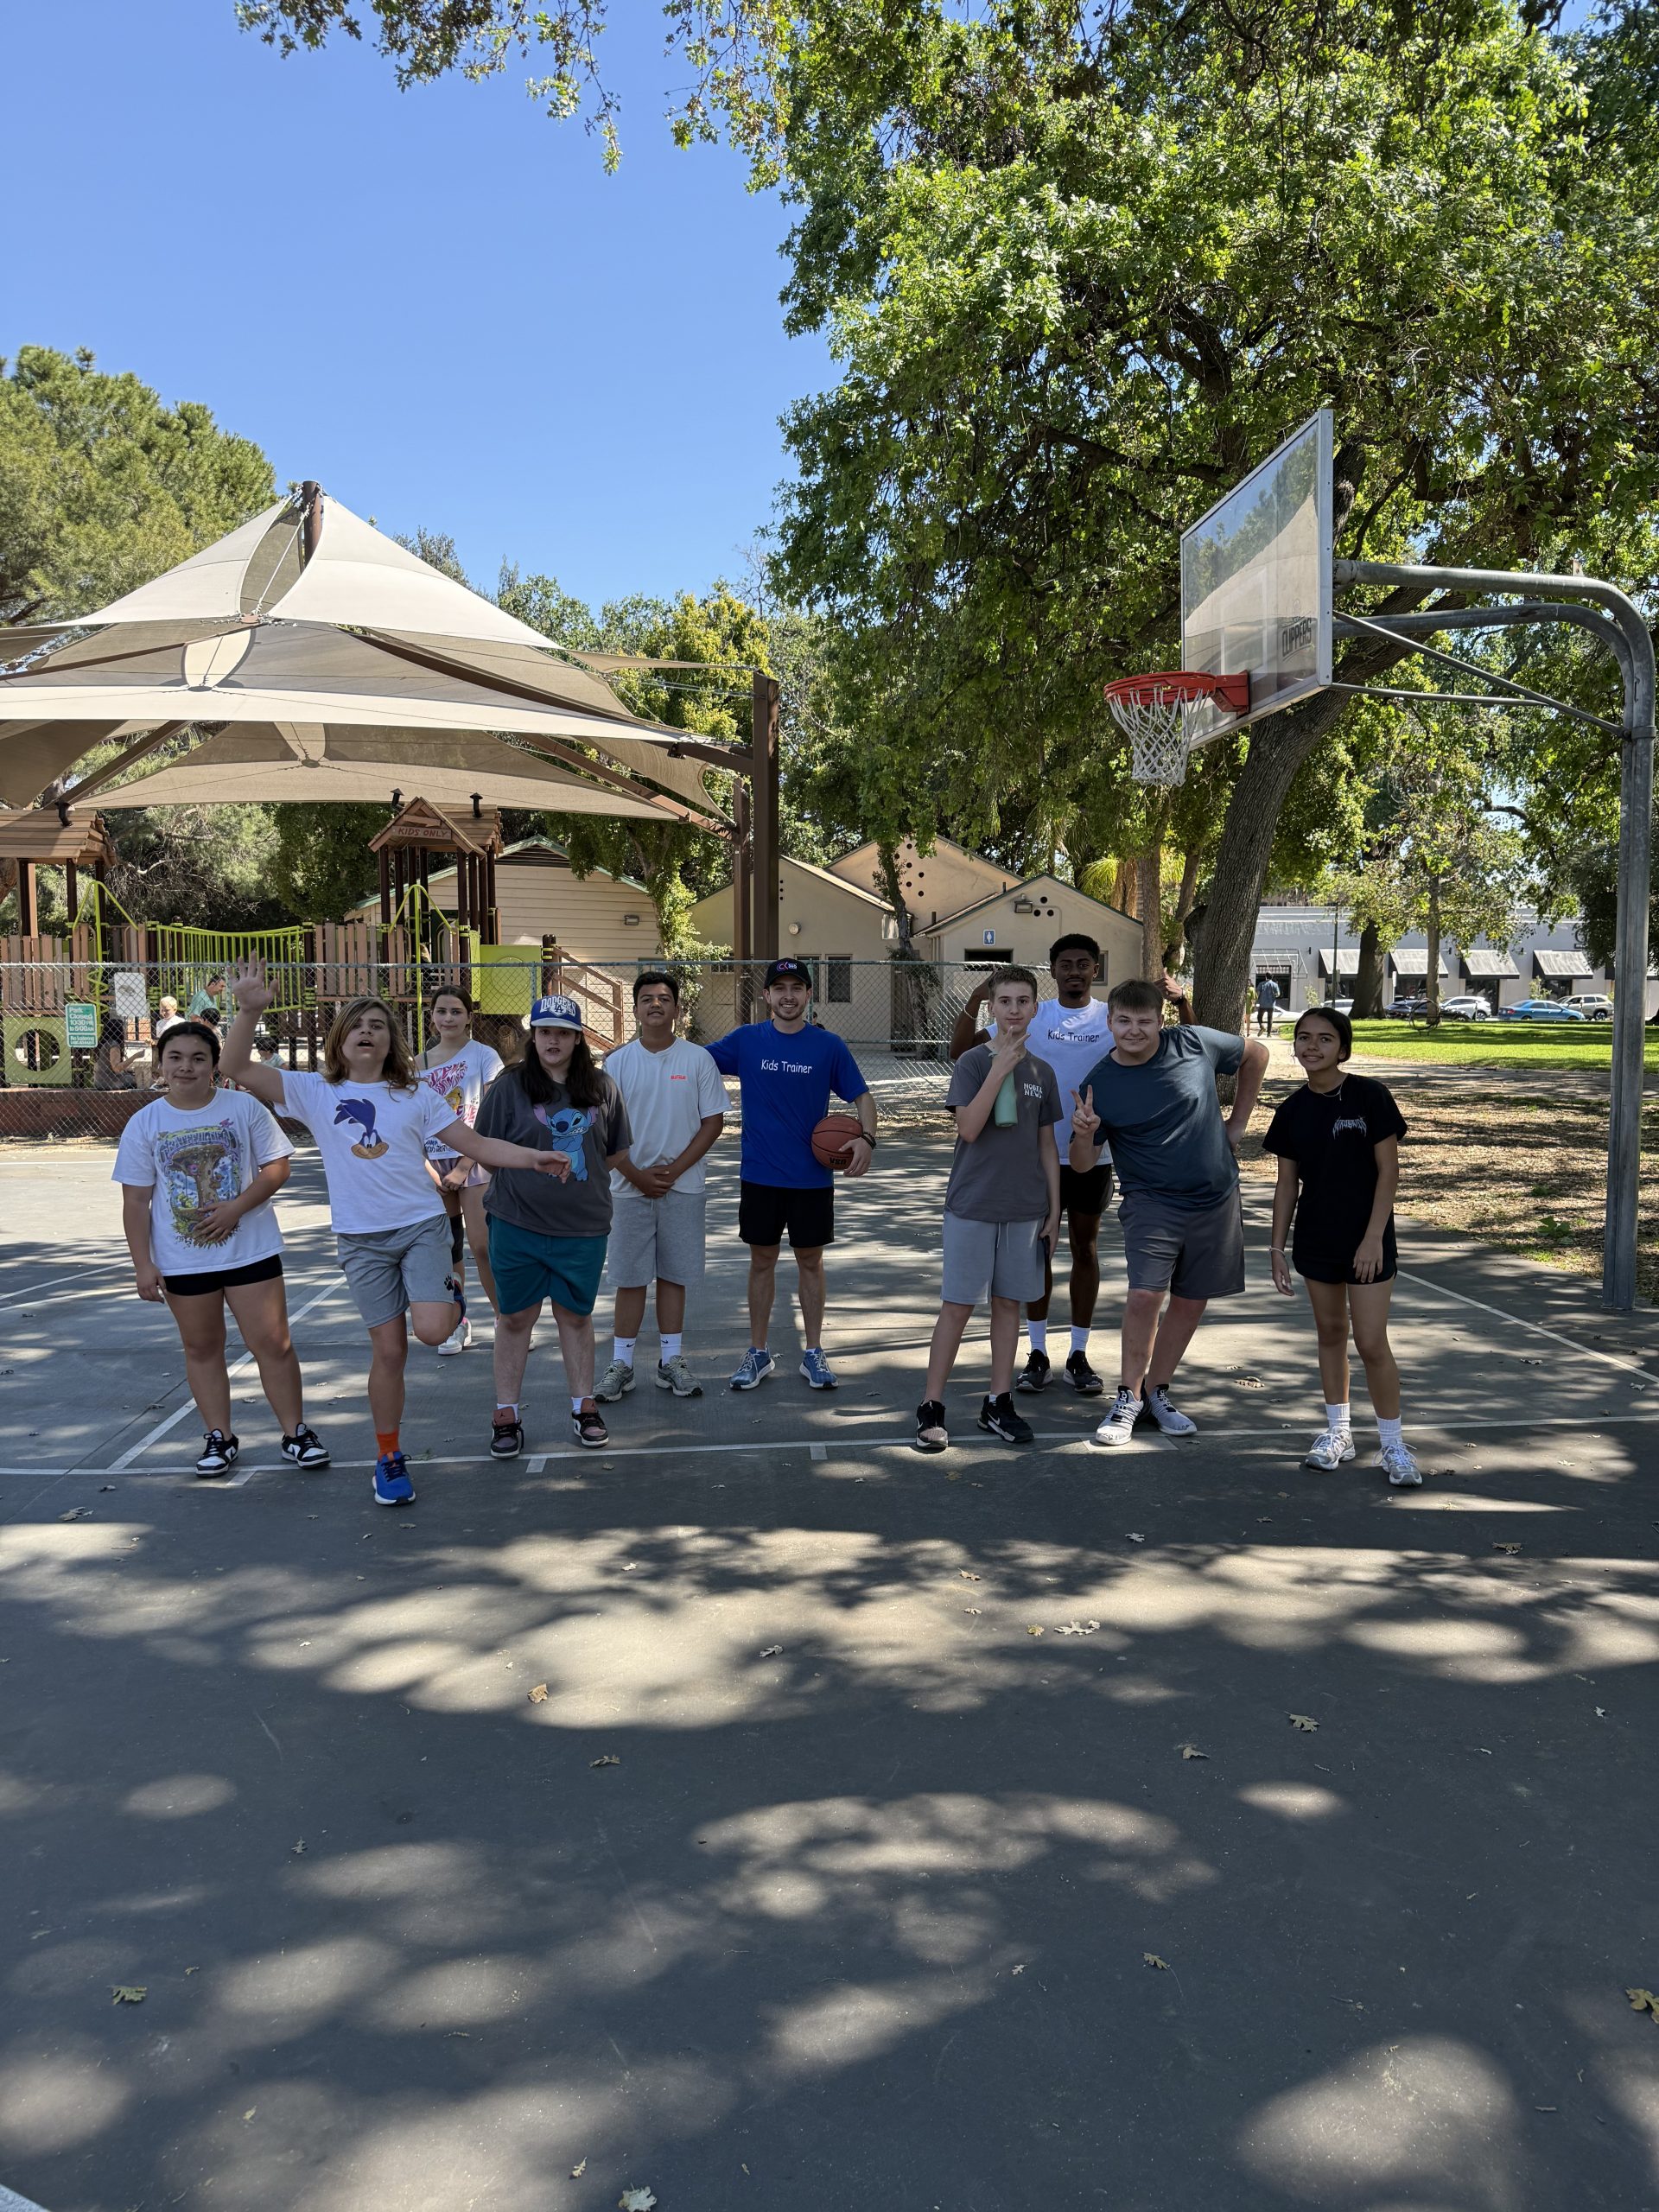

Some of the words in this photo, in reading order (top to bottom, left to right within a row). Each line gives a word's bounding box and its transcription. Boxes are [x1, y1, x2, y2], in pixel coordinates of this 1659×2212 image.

[540, 995, 575, 1017] DODGERS
[1047, 1029, 1065, 1040] Kids
[1067, 1032, 1100, 1043] Trainer
[760, 1058, 779, 1071] Kids
[781, 1060, 812, 1074] Trainer
[1024, 1090, 1042, 1099] NEWS
